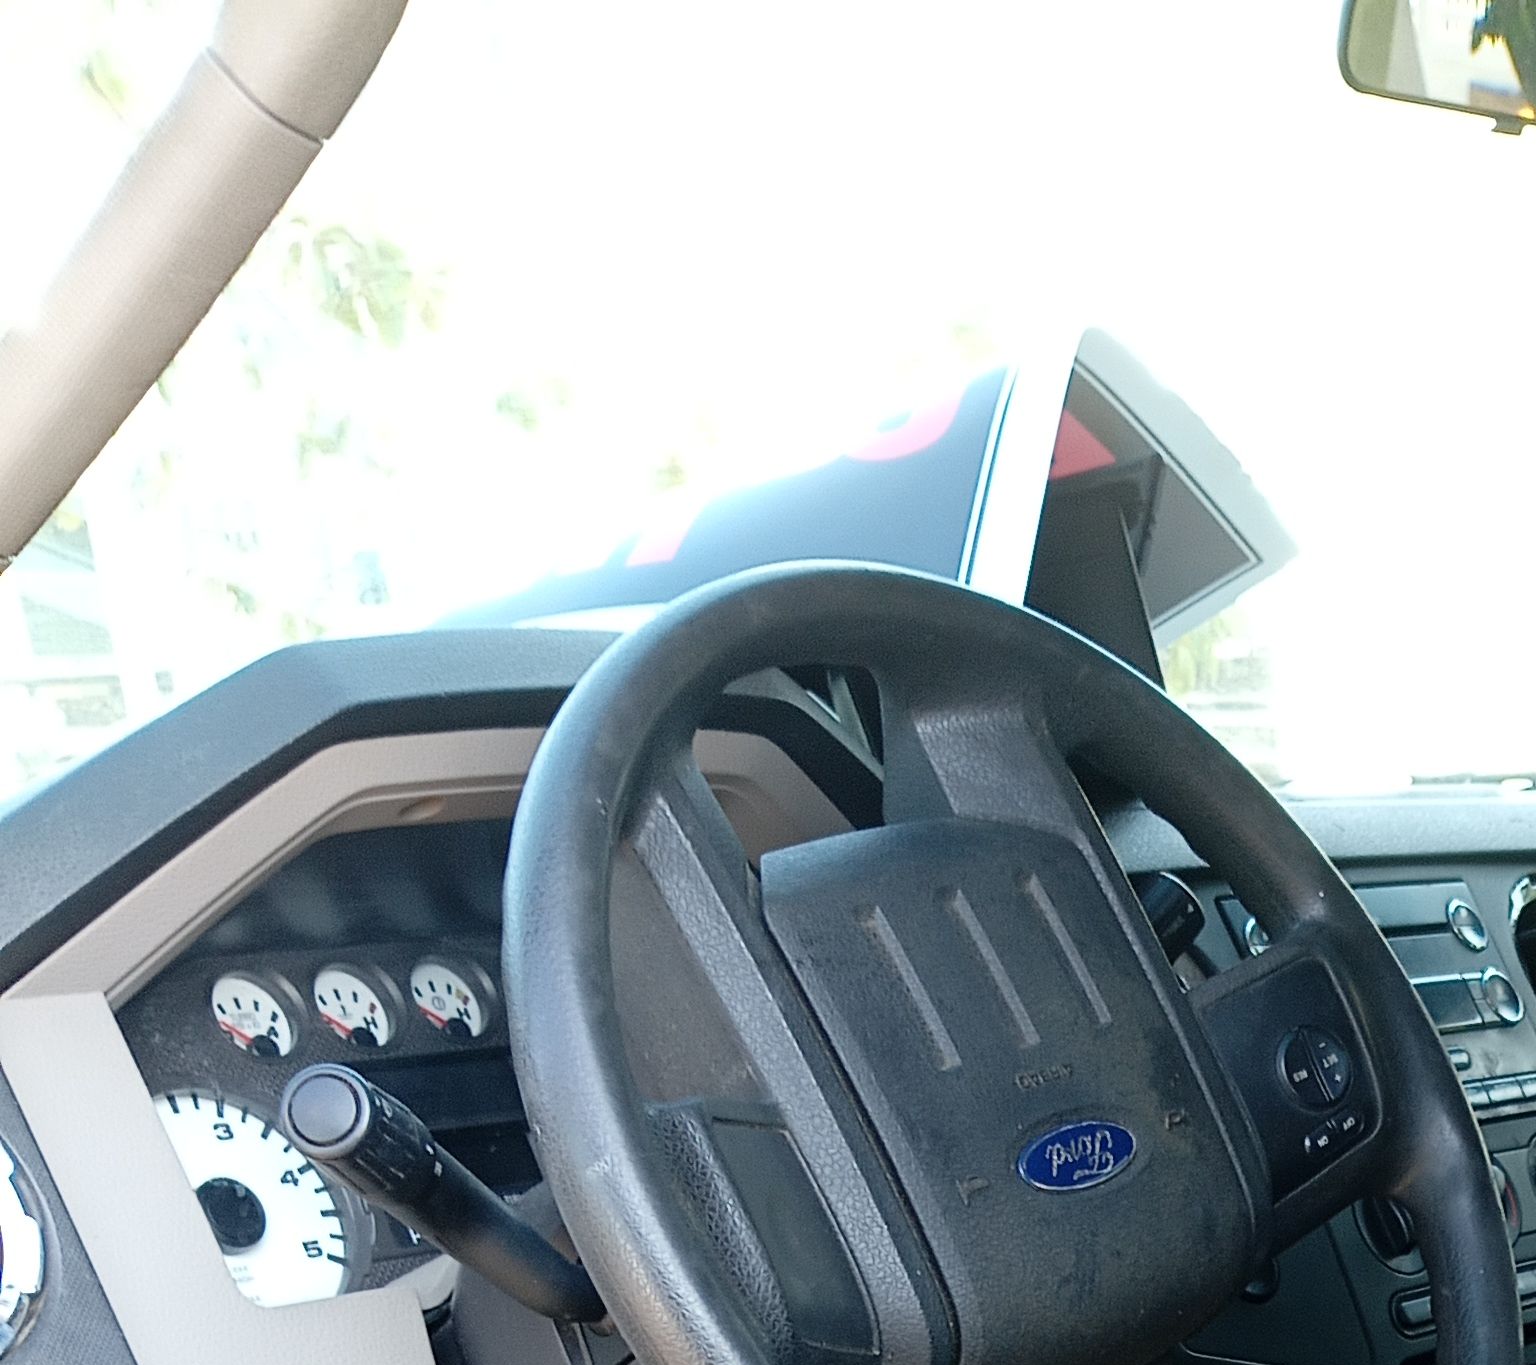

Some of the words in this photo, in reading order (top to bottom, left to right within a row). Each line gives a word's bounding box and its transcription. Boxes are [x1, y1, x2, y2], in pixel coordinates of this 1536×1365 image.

[213, 1122, 235, 1141] 3
[279, 1170, 300, 1187] 4
[302, 1240, 323, 1258] 5
